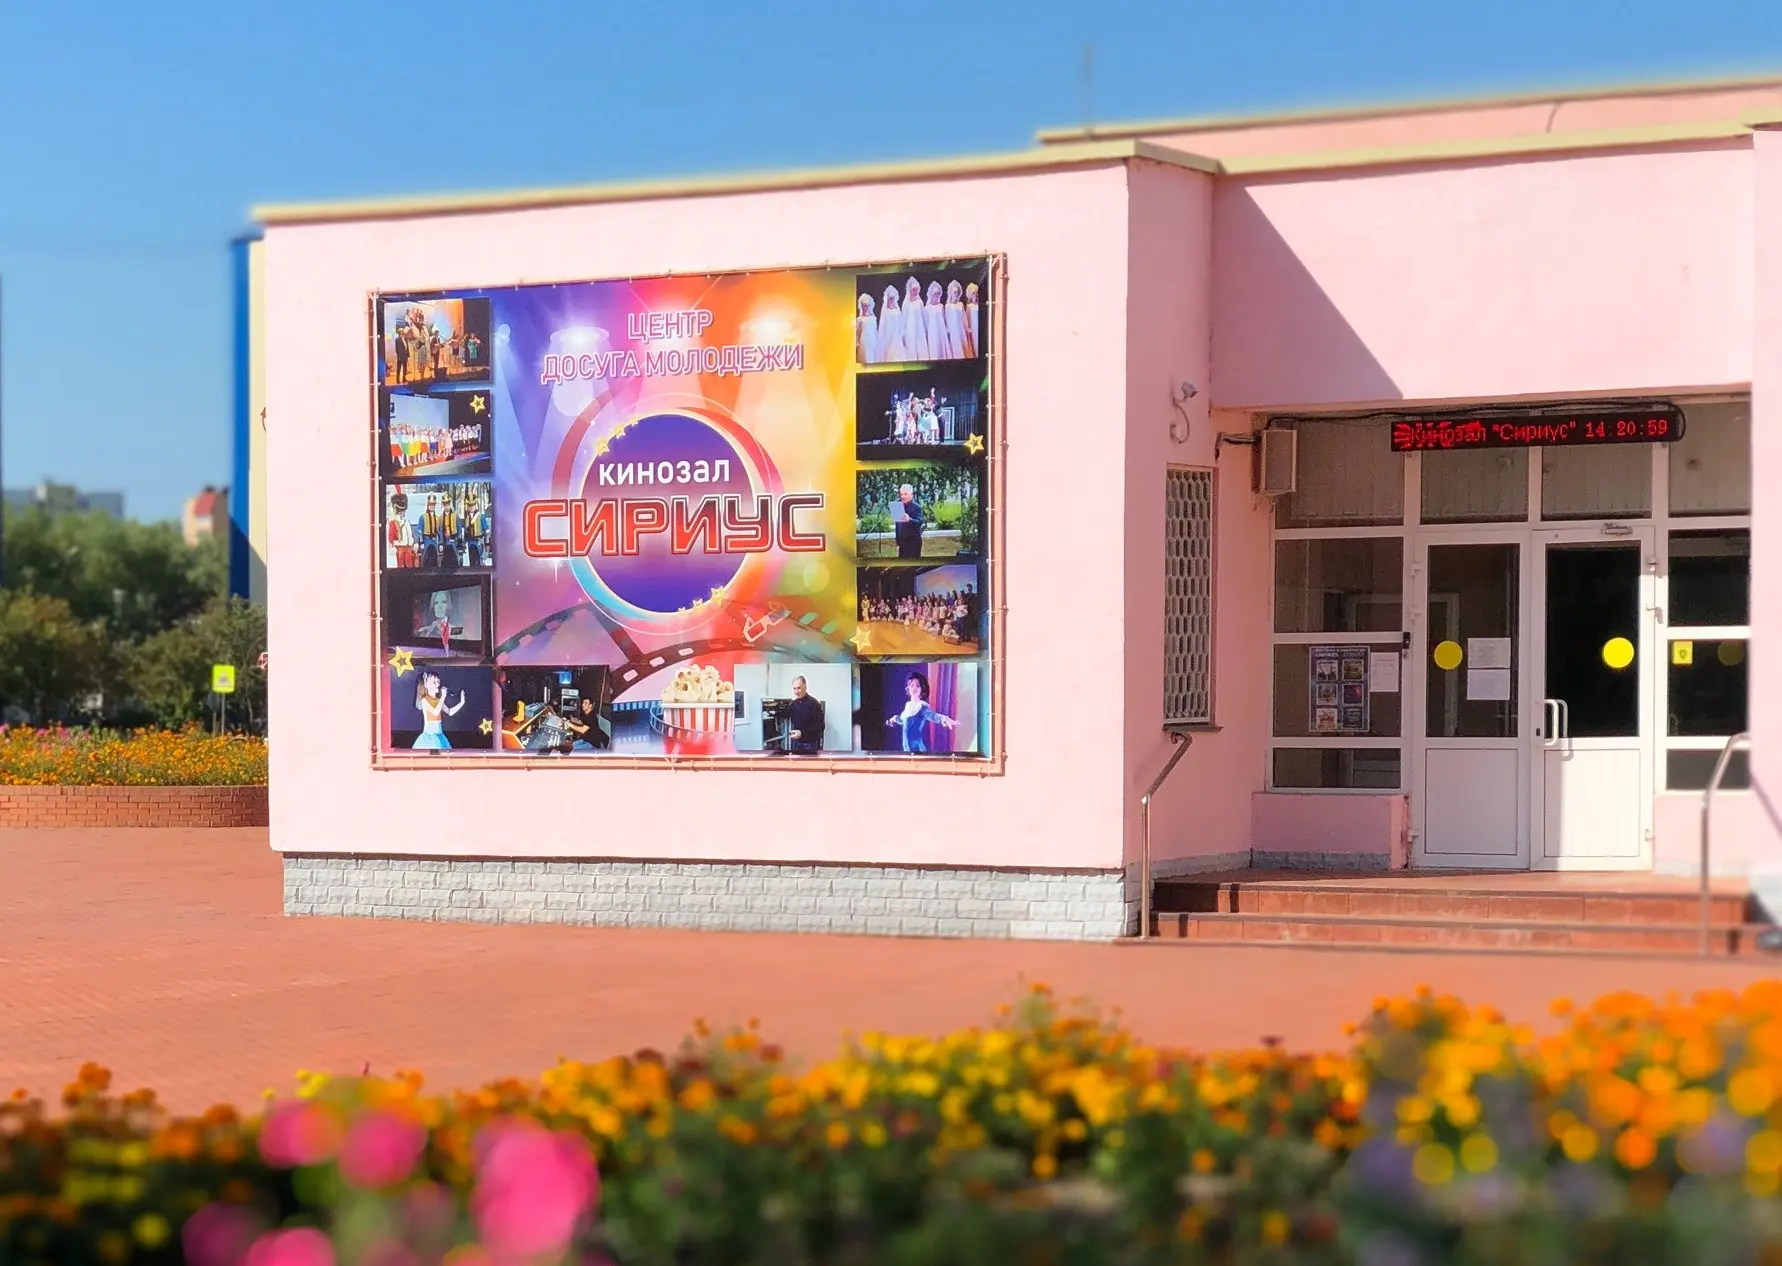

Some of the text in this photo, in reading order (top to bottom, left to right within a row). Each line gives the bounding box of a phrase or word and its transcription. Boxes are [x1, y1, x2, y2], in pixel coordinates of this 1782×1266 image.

[627, 310, 713, 343] ЦЕНТР
[541, 343, 805, 385] ДОСУГА МОЛОДЕЖИ
[1492, 420, 1577, 442] "Сириус"
[522, 493, 827, 558] СИРИУС
